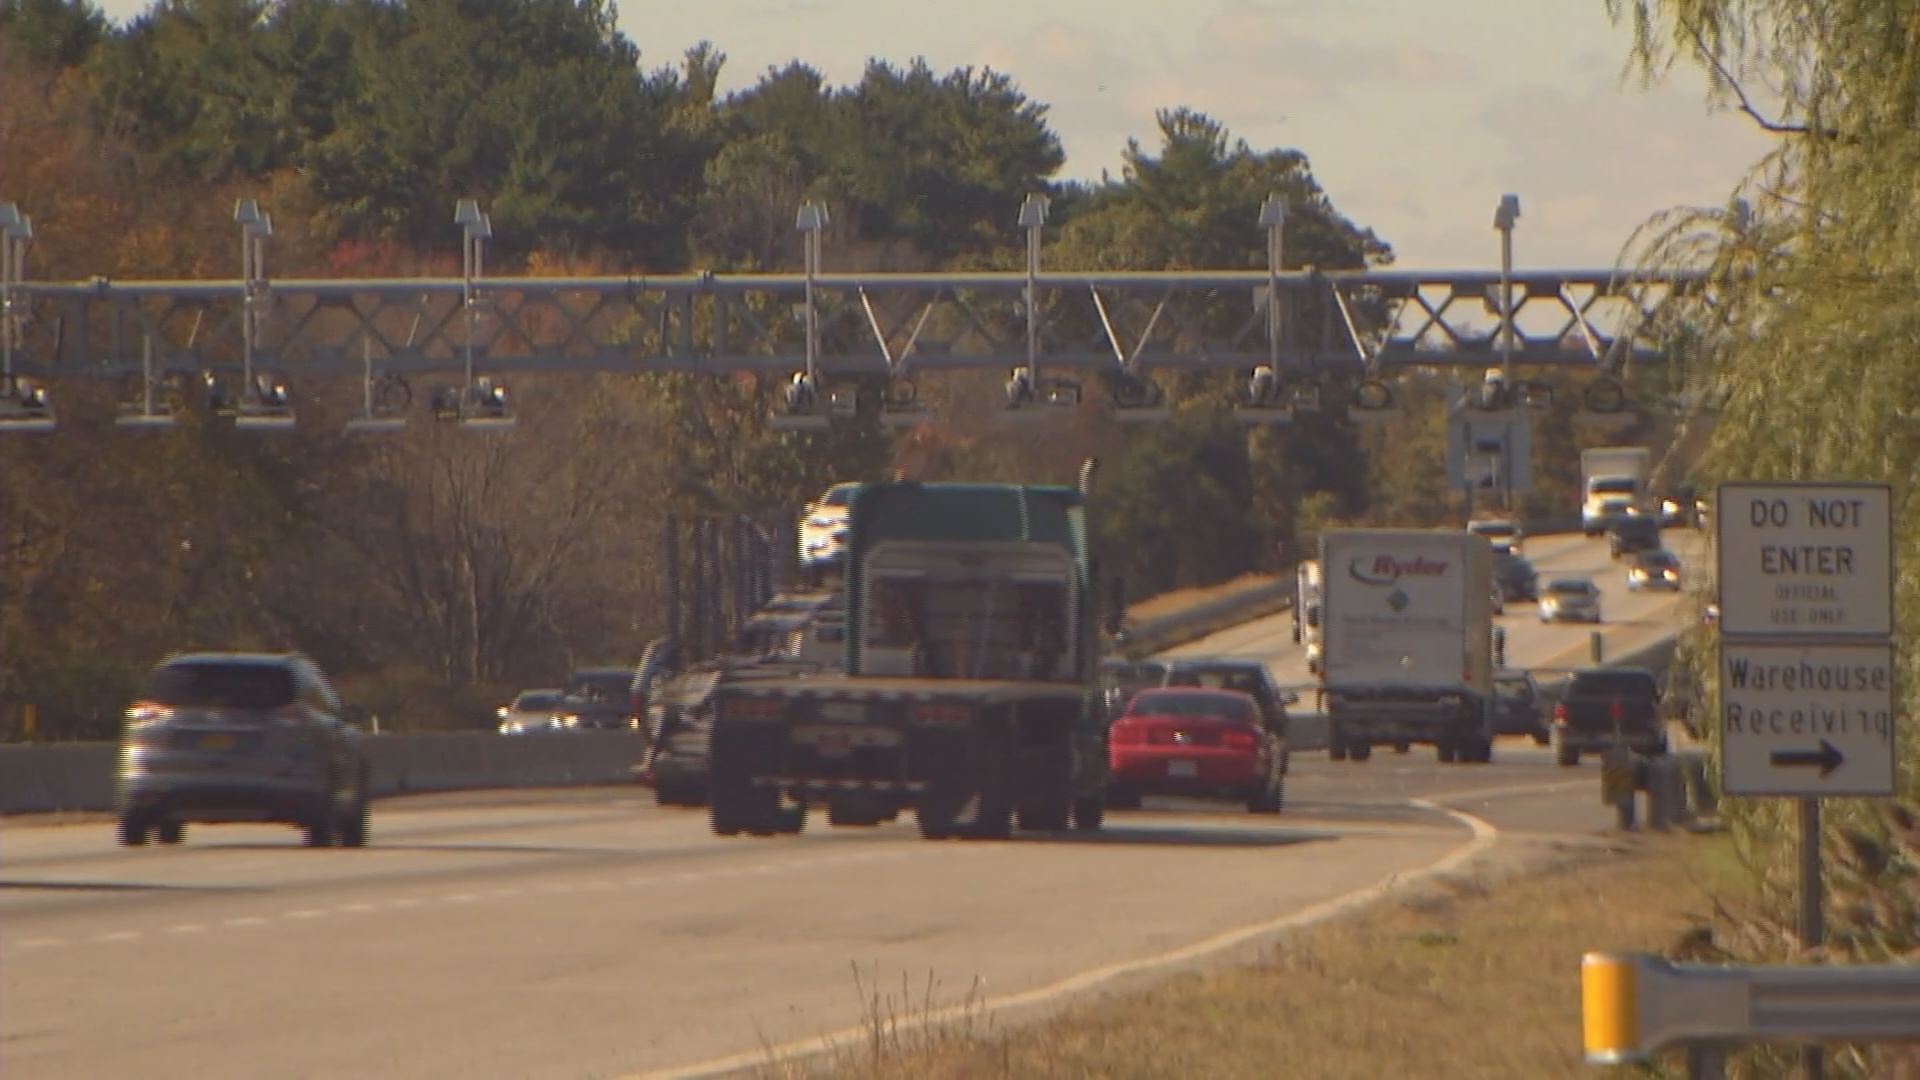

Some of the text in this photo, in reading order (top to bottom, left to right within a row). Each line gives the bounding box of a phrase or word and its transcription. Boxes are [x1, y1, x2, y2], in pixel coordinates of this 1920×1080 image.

[1751, 499, 1862, 527] DO NOT
[1372, 555, 1448, 578] Ryder
[1761, 546, 1853, 574] ENTER
[1775, 584, 1838, 600] OFFICIAL
[1771, 608, 1844, 624] USE ONLY
[1728, 657, 1885, 691] Warehouse
